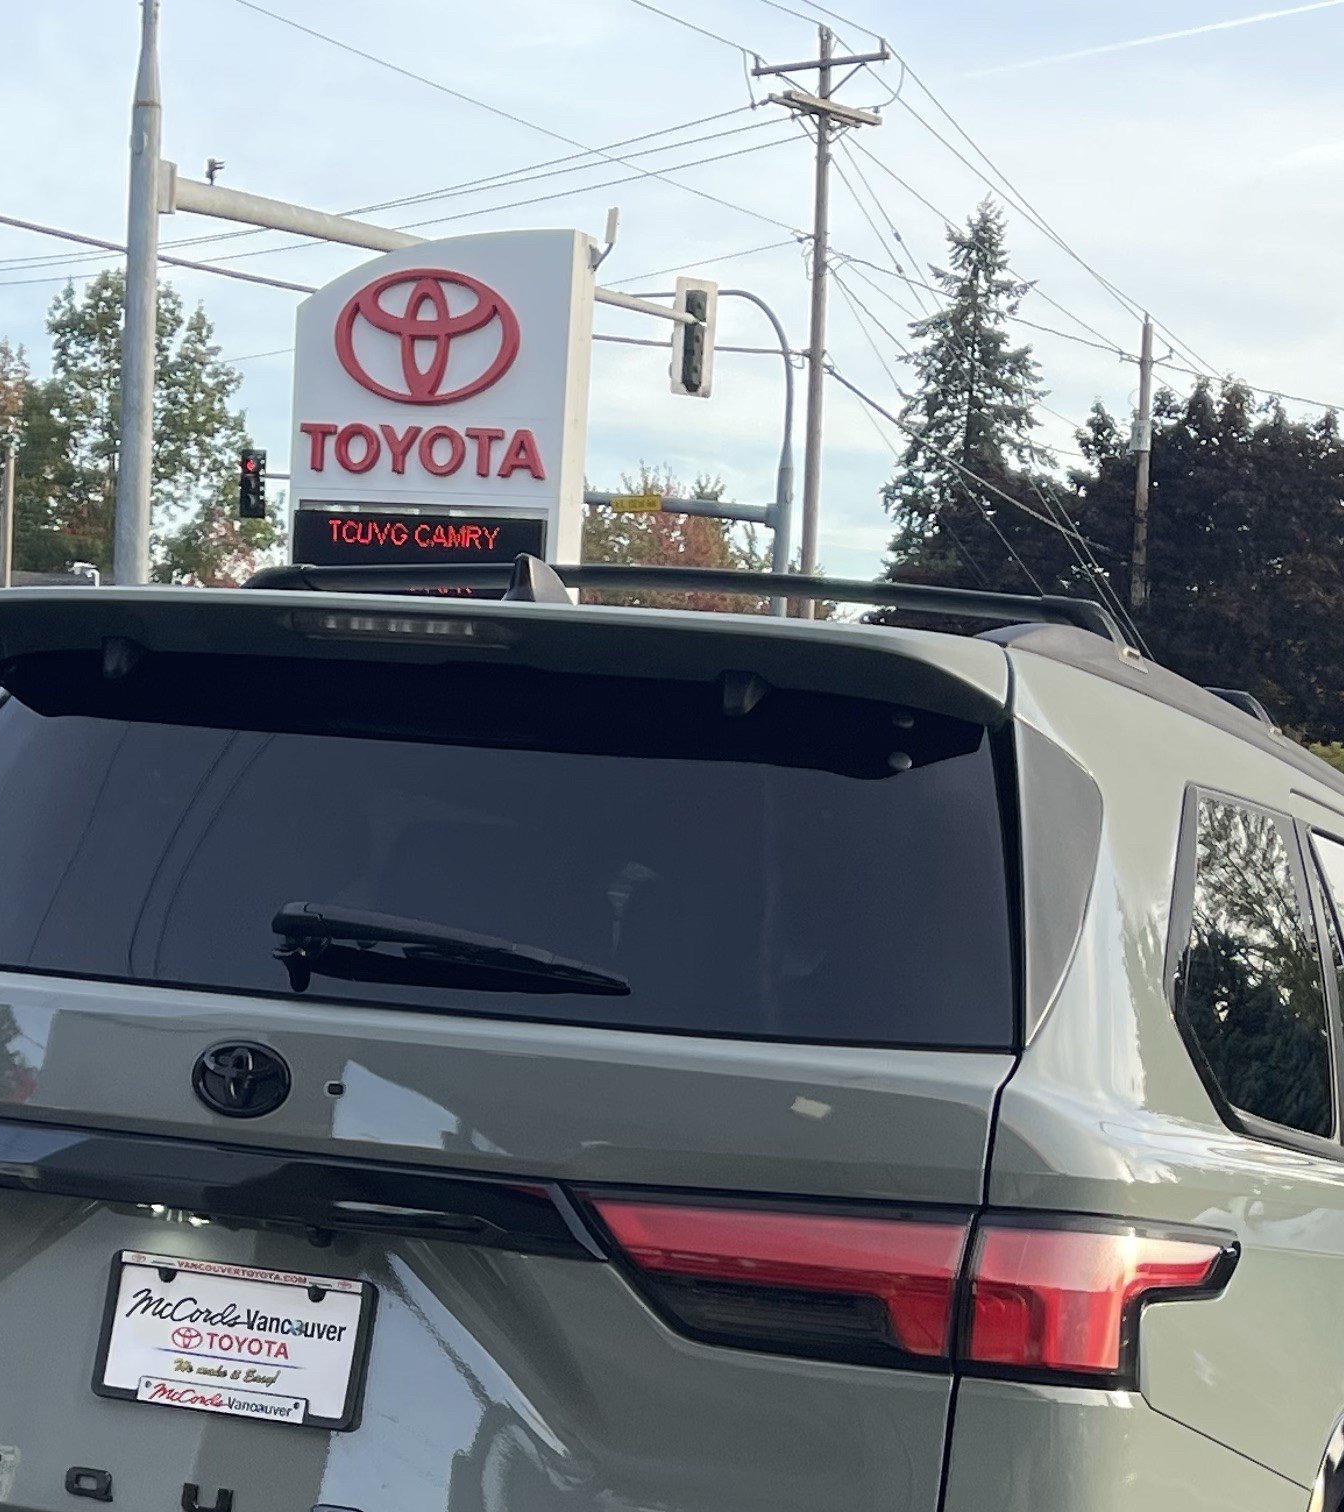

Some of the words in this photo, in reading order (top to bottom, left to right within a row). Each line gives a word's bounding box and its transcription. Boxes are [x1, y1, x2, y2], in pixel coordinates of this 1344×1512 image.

[300, 423, 545, 480] TOYOTA
[414, 523, 500, 550] CAMRY
[176, 1260, 308, 1285] VANCOUVERTOYOTA.COM
[206, 1332, 290, 1360] TOYOTA
